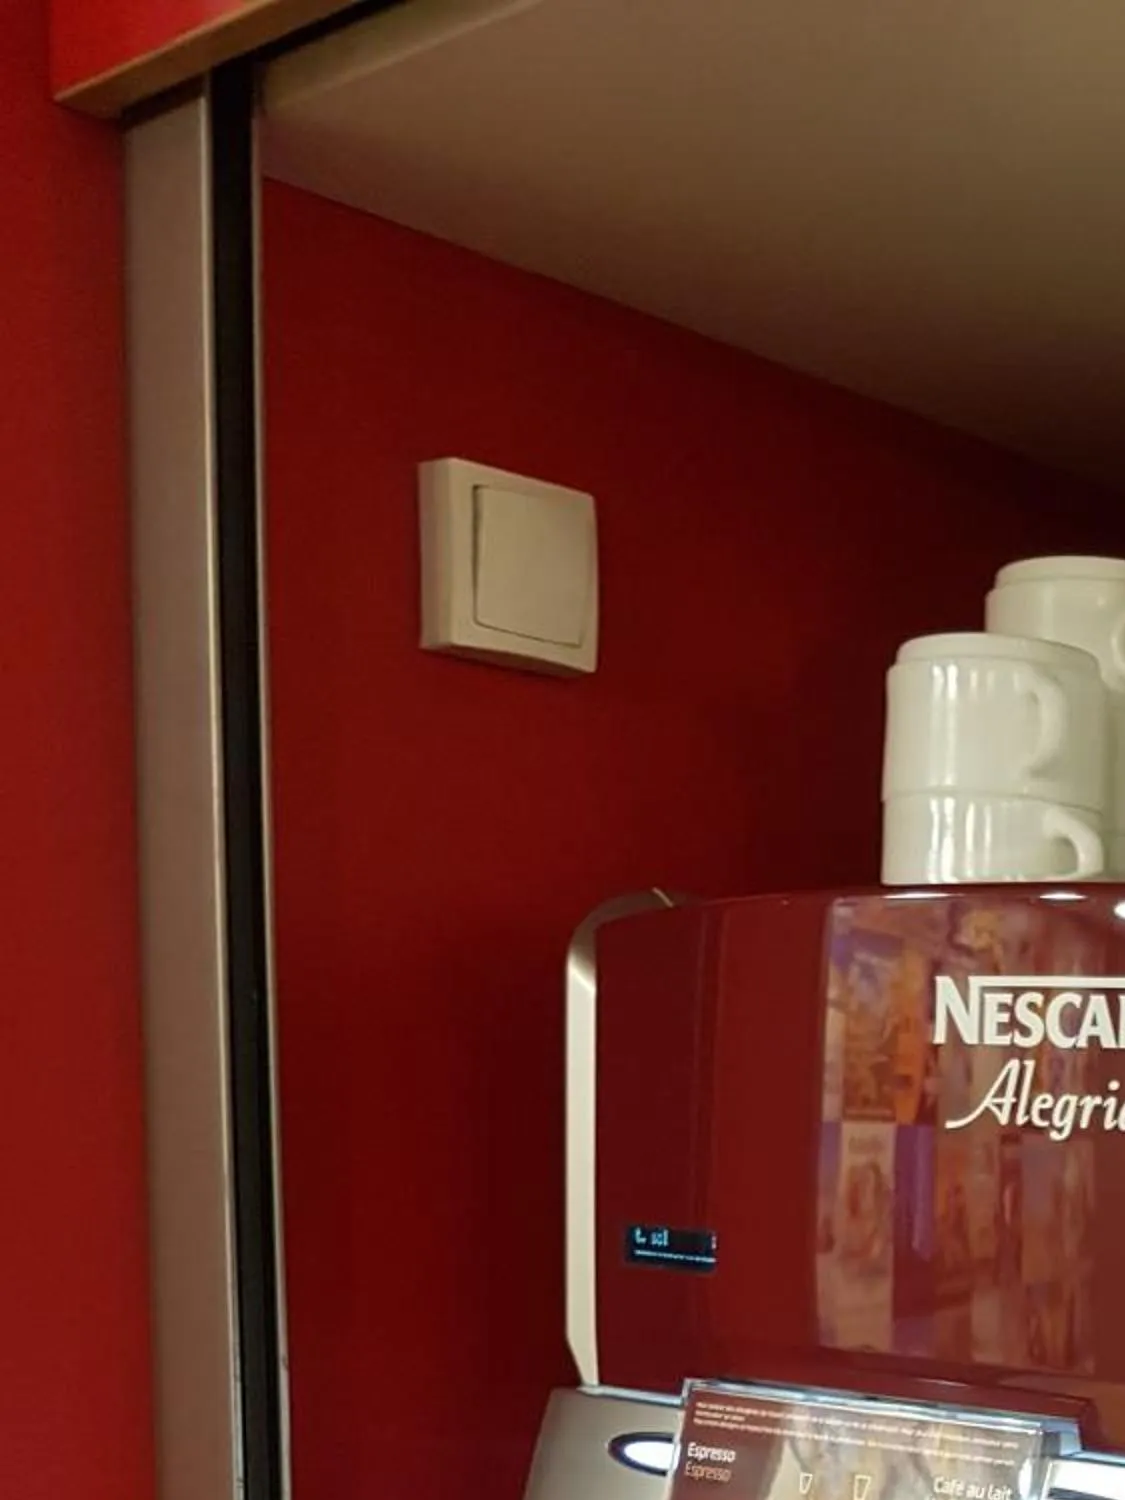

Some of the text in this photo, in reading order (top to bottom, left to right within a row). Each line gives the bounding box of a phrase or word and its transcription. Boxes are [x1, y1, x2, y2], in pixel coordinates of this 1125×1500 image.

[687, 1442, 736, 1463] Espresso
[685, 1461, 732, 1482] Espresso
[934, 1477, 964, 1496] Café
[966, 1485, 984, 1499] au
